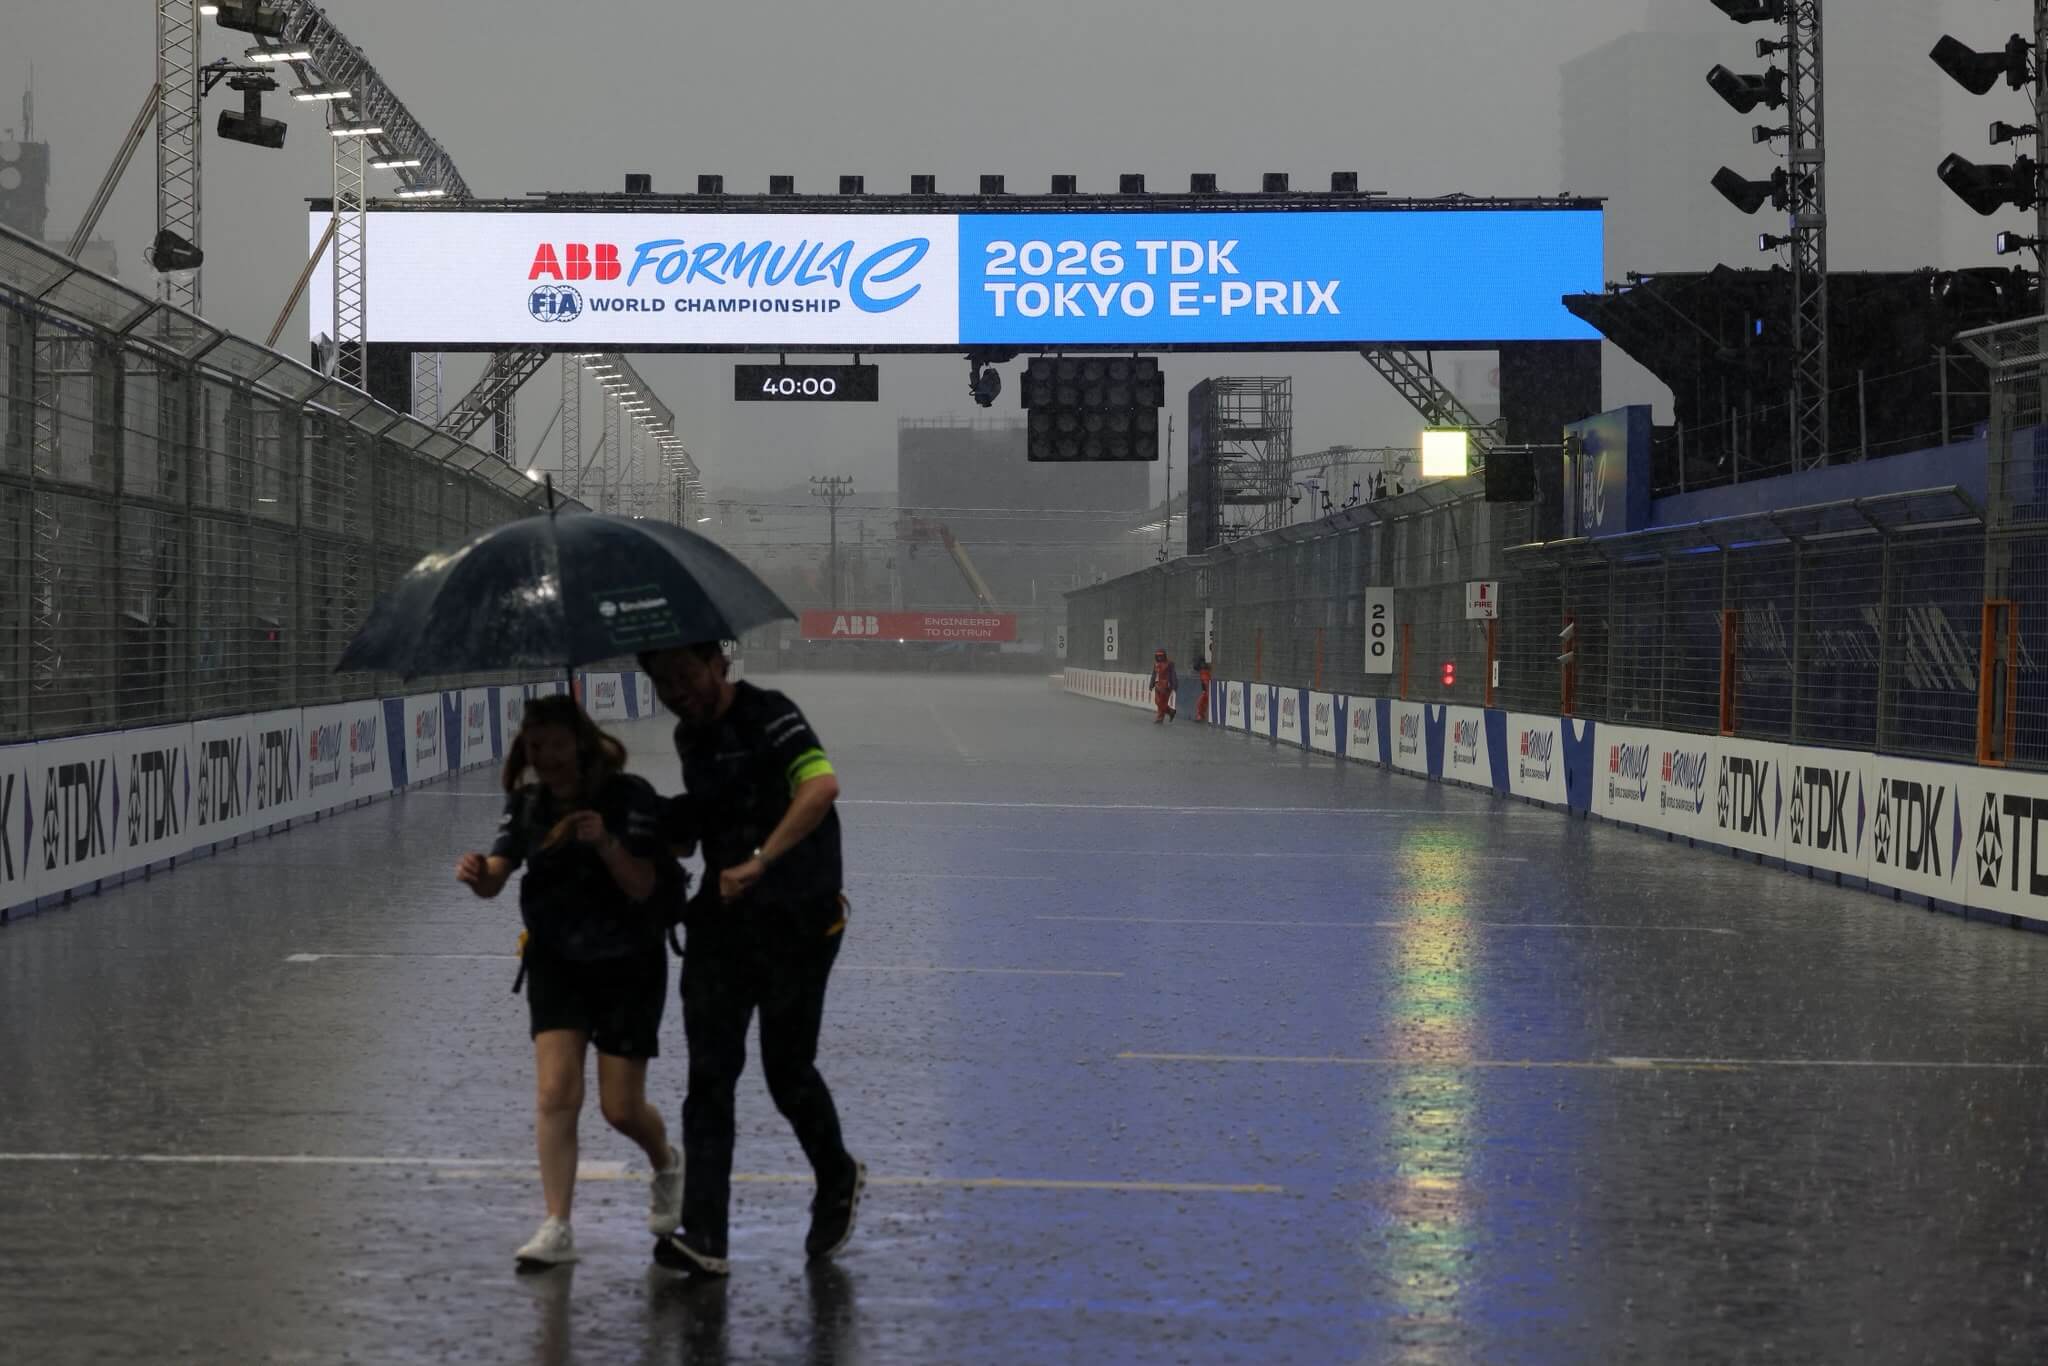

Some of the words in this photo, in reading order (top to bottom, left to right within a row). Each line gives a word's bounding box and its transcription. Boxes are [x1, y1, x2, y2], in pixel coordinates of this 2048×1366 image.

[528, 243, 622, 281] ABB
[626, 239, 856, 287] FORMULA
[985, 240, 1124, 276] 2026
[1135, 239, 1240, 275] TDK
[589, 298, 665, 312] WORLD
[675, 298, 841, 312] CHAMPIONSHIP
[984, 281, 1154, 317] TOKYO
[1169, 280, 1341, 316] E-PRIX
[762, 377, 836, 395] 40:00
[831, 615, 880, 635] ABB
[924, 628, 941, 636] TO
[943, 628, 992, 637] OUTRUN
[925, 617, 1001, 626] ENGINEERED
[1371, 604, 1386, 656] 200
[209, 736, 241, 823] TDK
[266, 727, 293, 807] TDK
[1671, 750, 1698, 791] FORMULA
[59, 759, 105, 865] TDK
[141, 747, 179, 843] TDK
[1729, 756, 1769, 837] TDK
[1804, 766, 1850, 853] TDK
[1892, 779, 1945, 877] TDK
